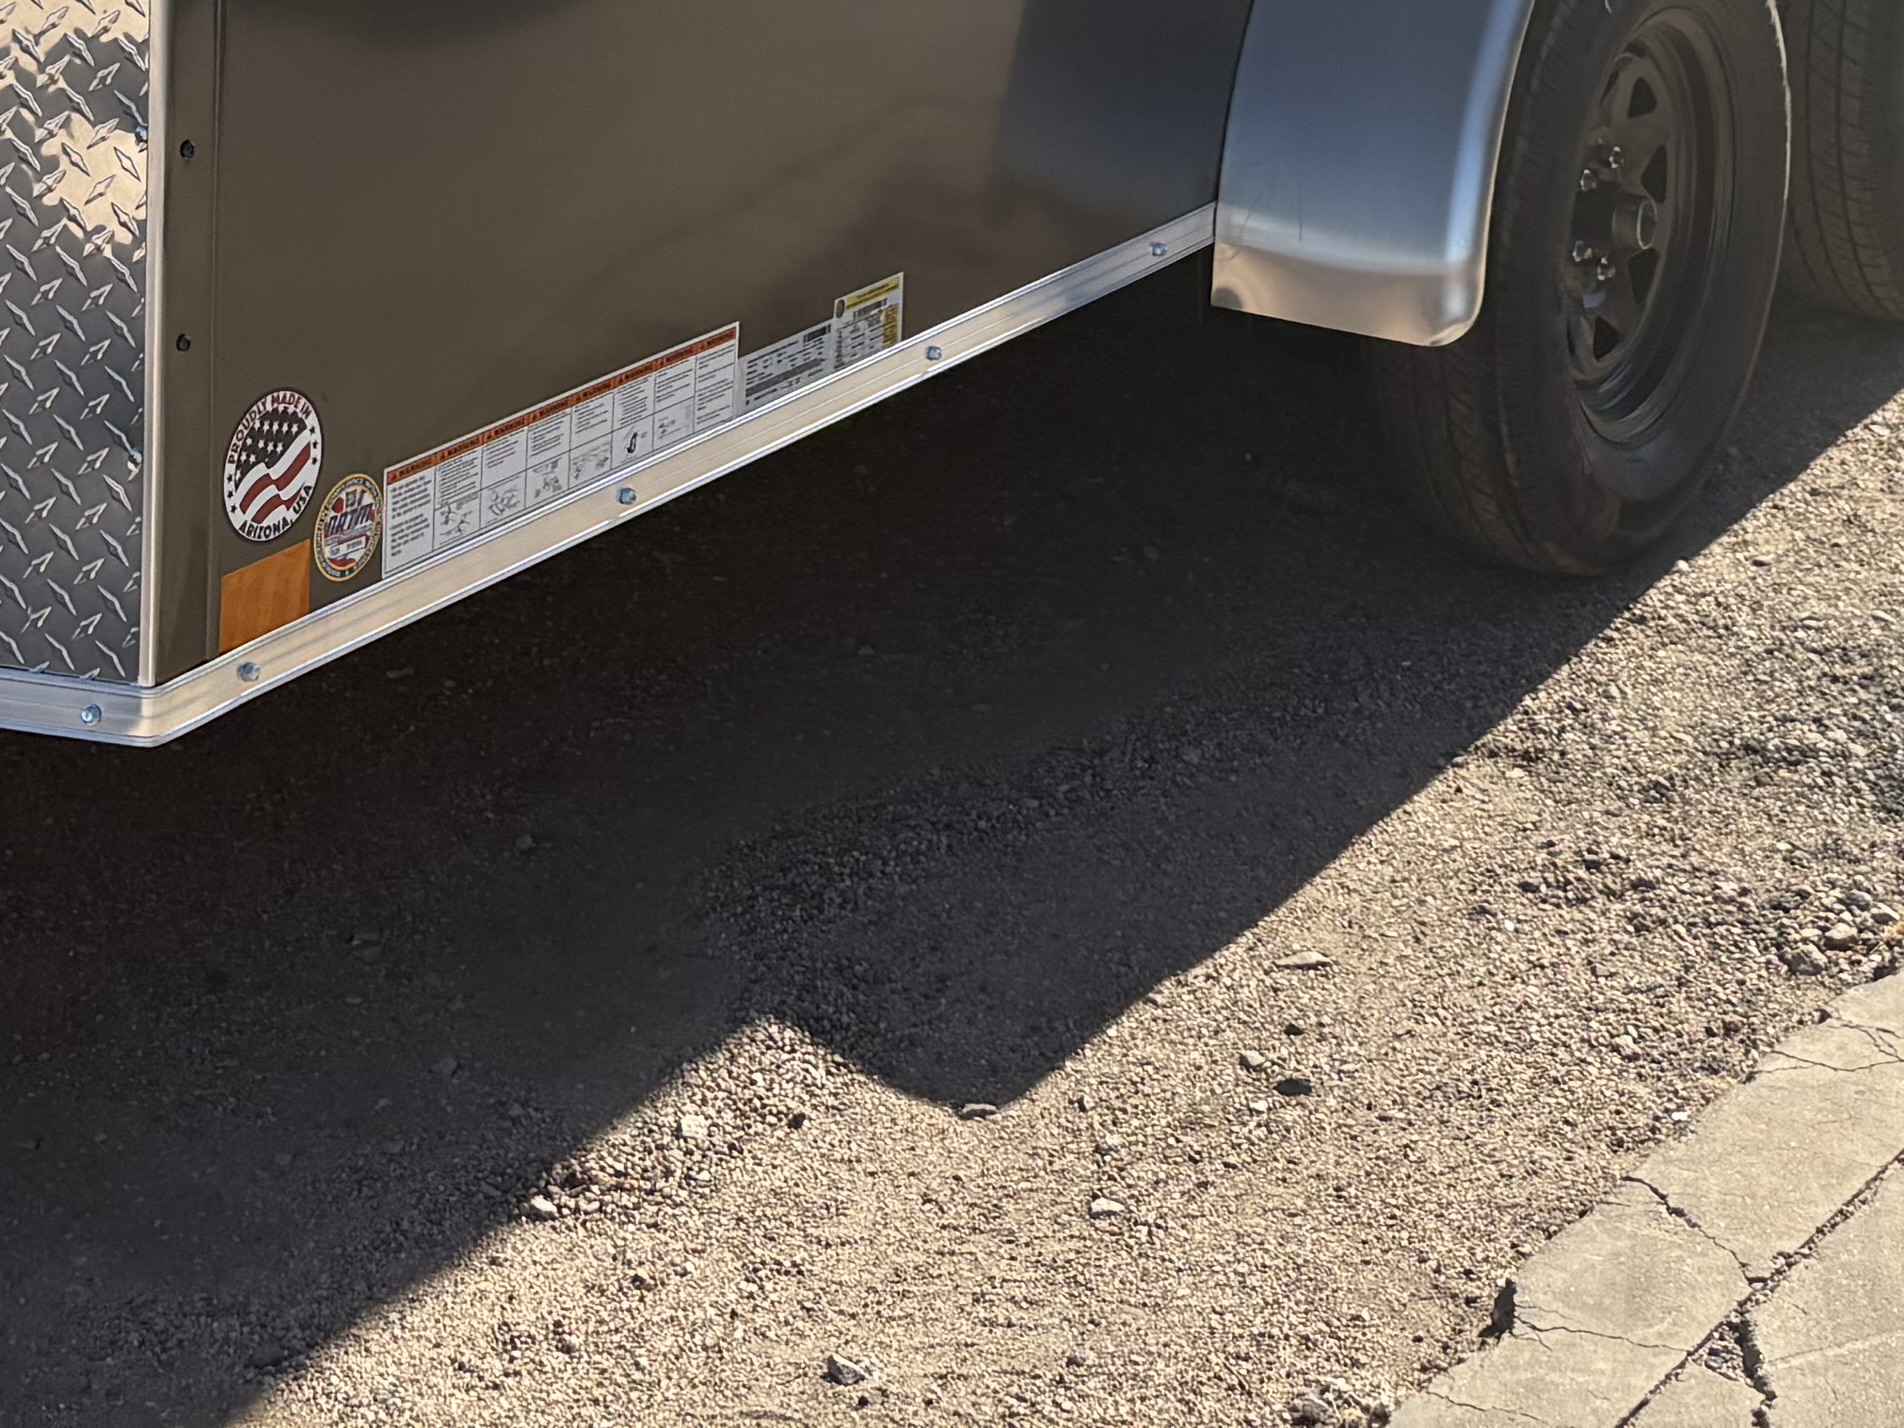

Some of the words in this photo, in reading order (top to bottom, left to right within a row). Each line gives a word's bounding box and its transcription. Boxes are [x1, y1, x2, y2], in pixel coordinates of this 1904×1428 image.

[227, 396, 269, 465] PROUDLY
[271, 392, 301, 410] MADE
[301, 401, 313, 420] IN
[239, 518, 294, 540] ARIZONA,
[292, 485, 313, 515] USA
